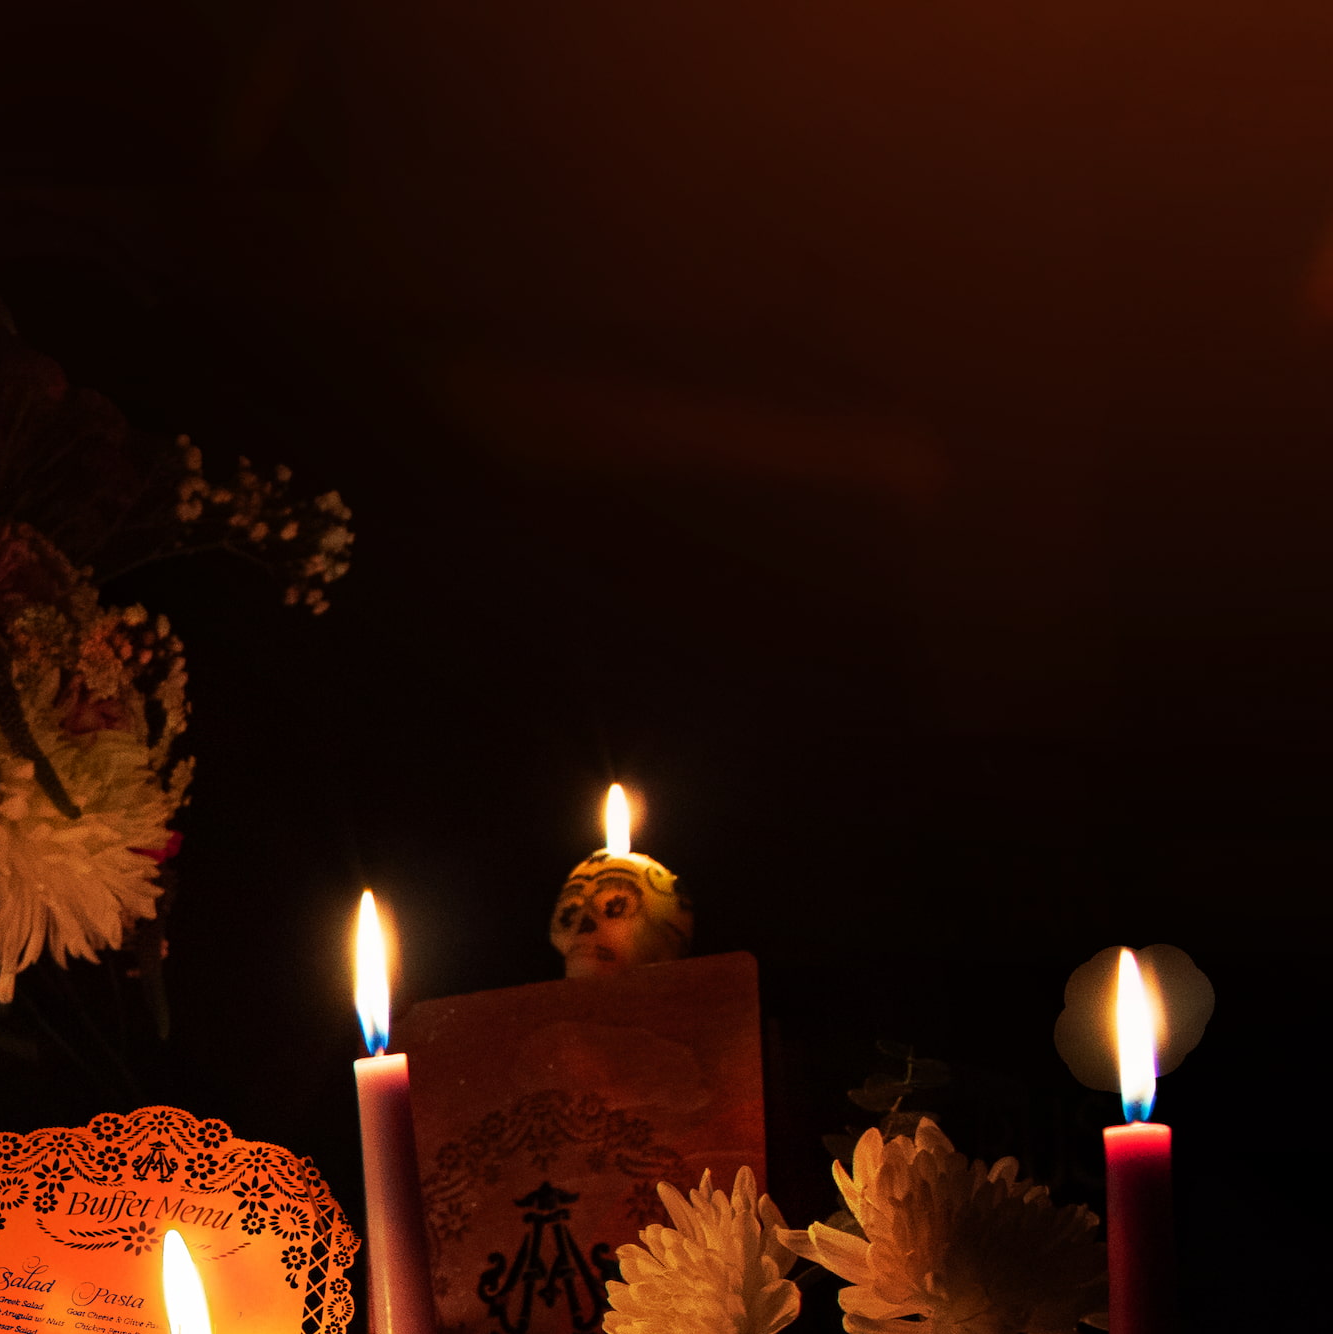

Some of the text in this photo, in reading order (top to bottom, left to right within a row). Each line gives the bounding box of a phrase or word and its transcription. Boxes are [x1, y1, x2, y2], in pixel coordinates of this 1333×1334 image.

[65, 1190, 234, 1231] Buffet Menu
[71, 1281, 145, 1309] Pasta
[21, 1299, 45, 1310] Salad
[1, 1310, 34, 1321] Arugula
[46, 1317, 65, 1327] Nuts
[66, 1307, 86, 1317] Goat
[87, 1311, 114, 1322] Cheese
